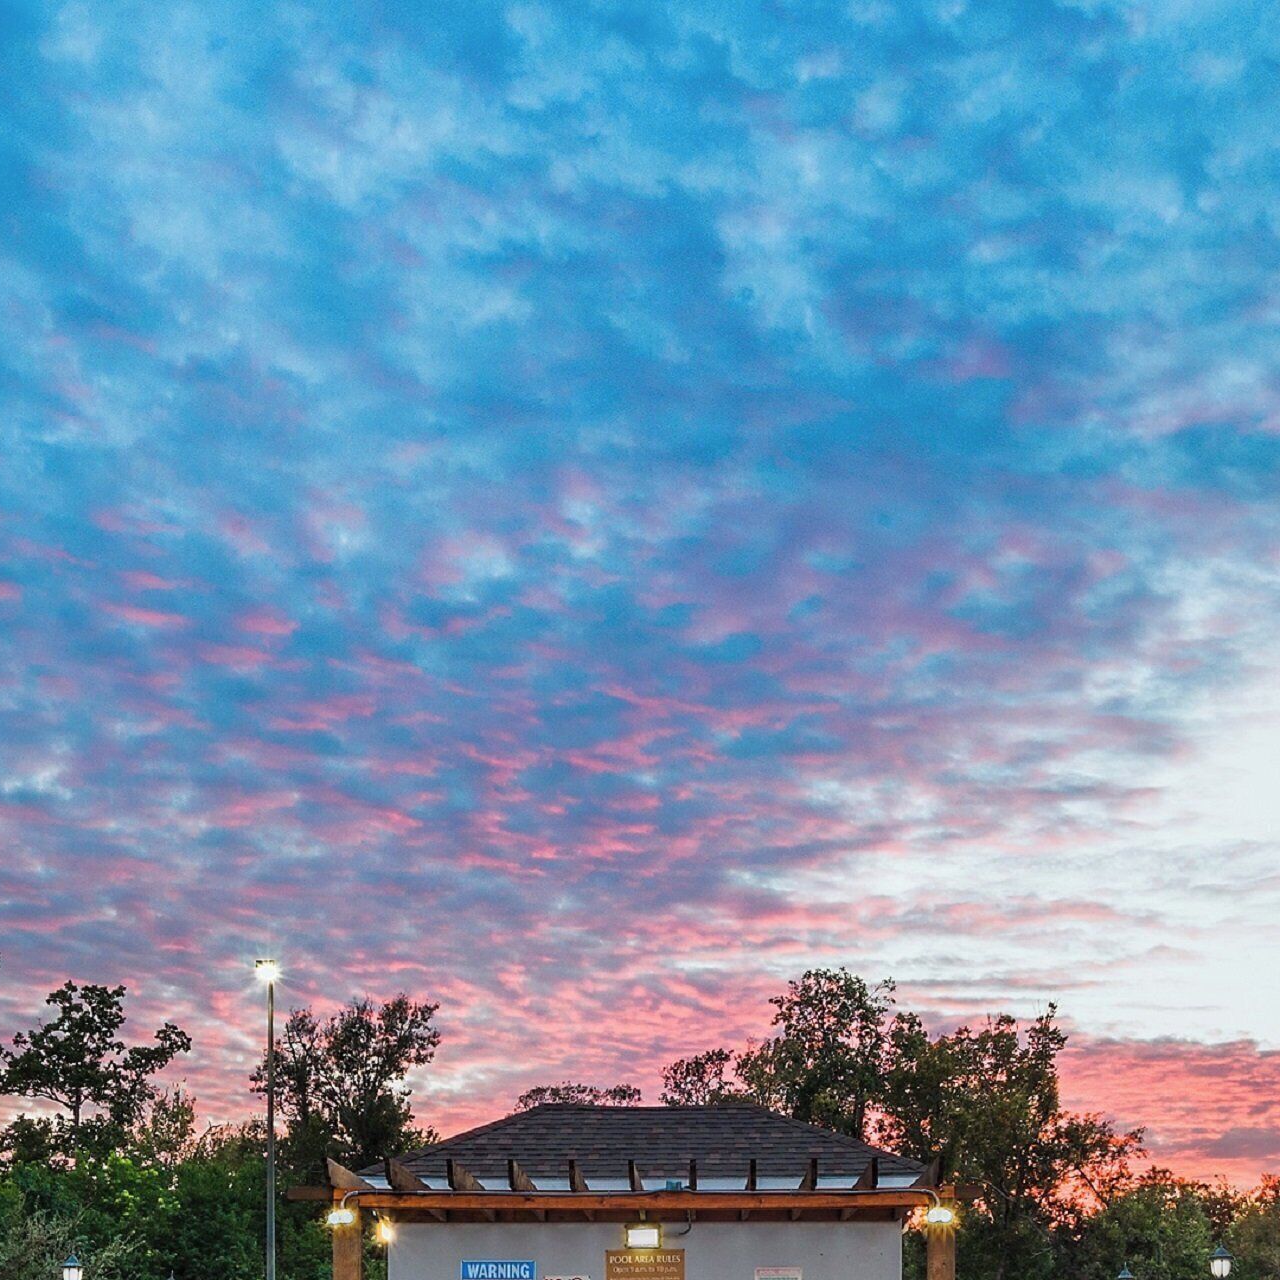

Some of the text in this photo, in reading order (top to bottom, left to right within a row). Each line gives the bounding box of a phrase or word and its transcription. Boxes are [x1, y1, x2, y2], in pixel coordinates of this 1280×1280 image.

[609, 1255, 681, 1264] POOL AREA RULES
[467, 1263, 530, 1279] WARNING
